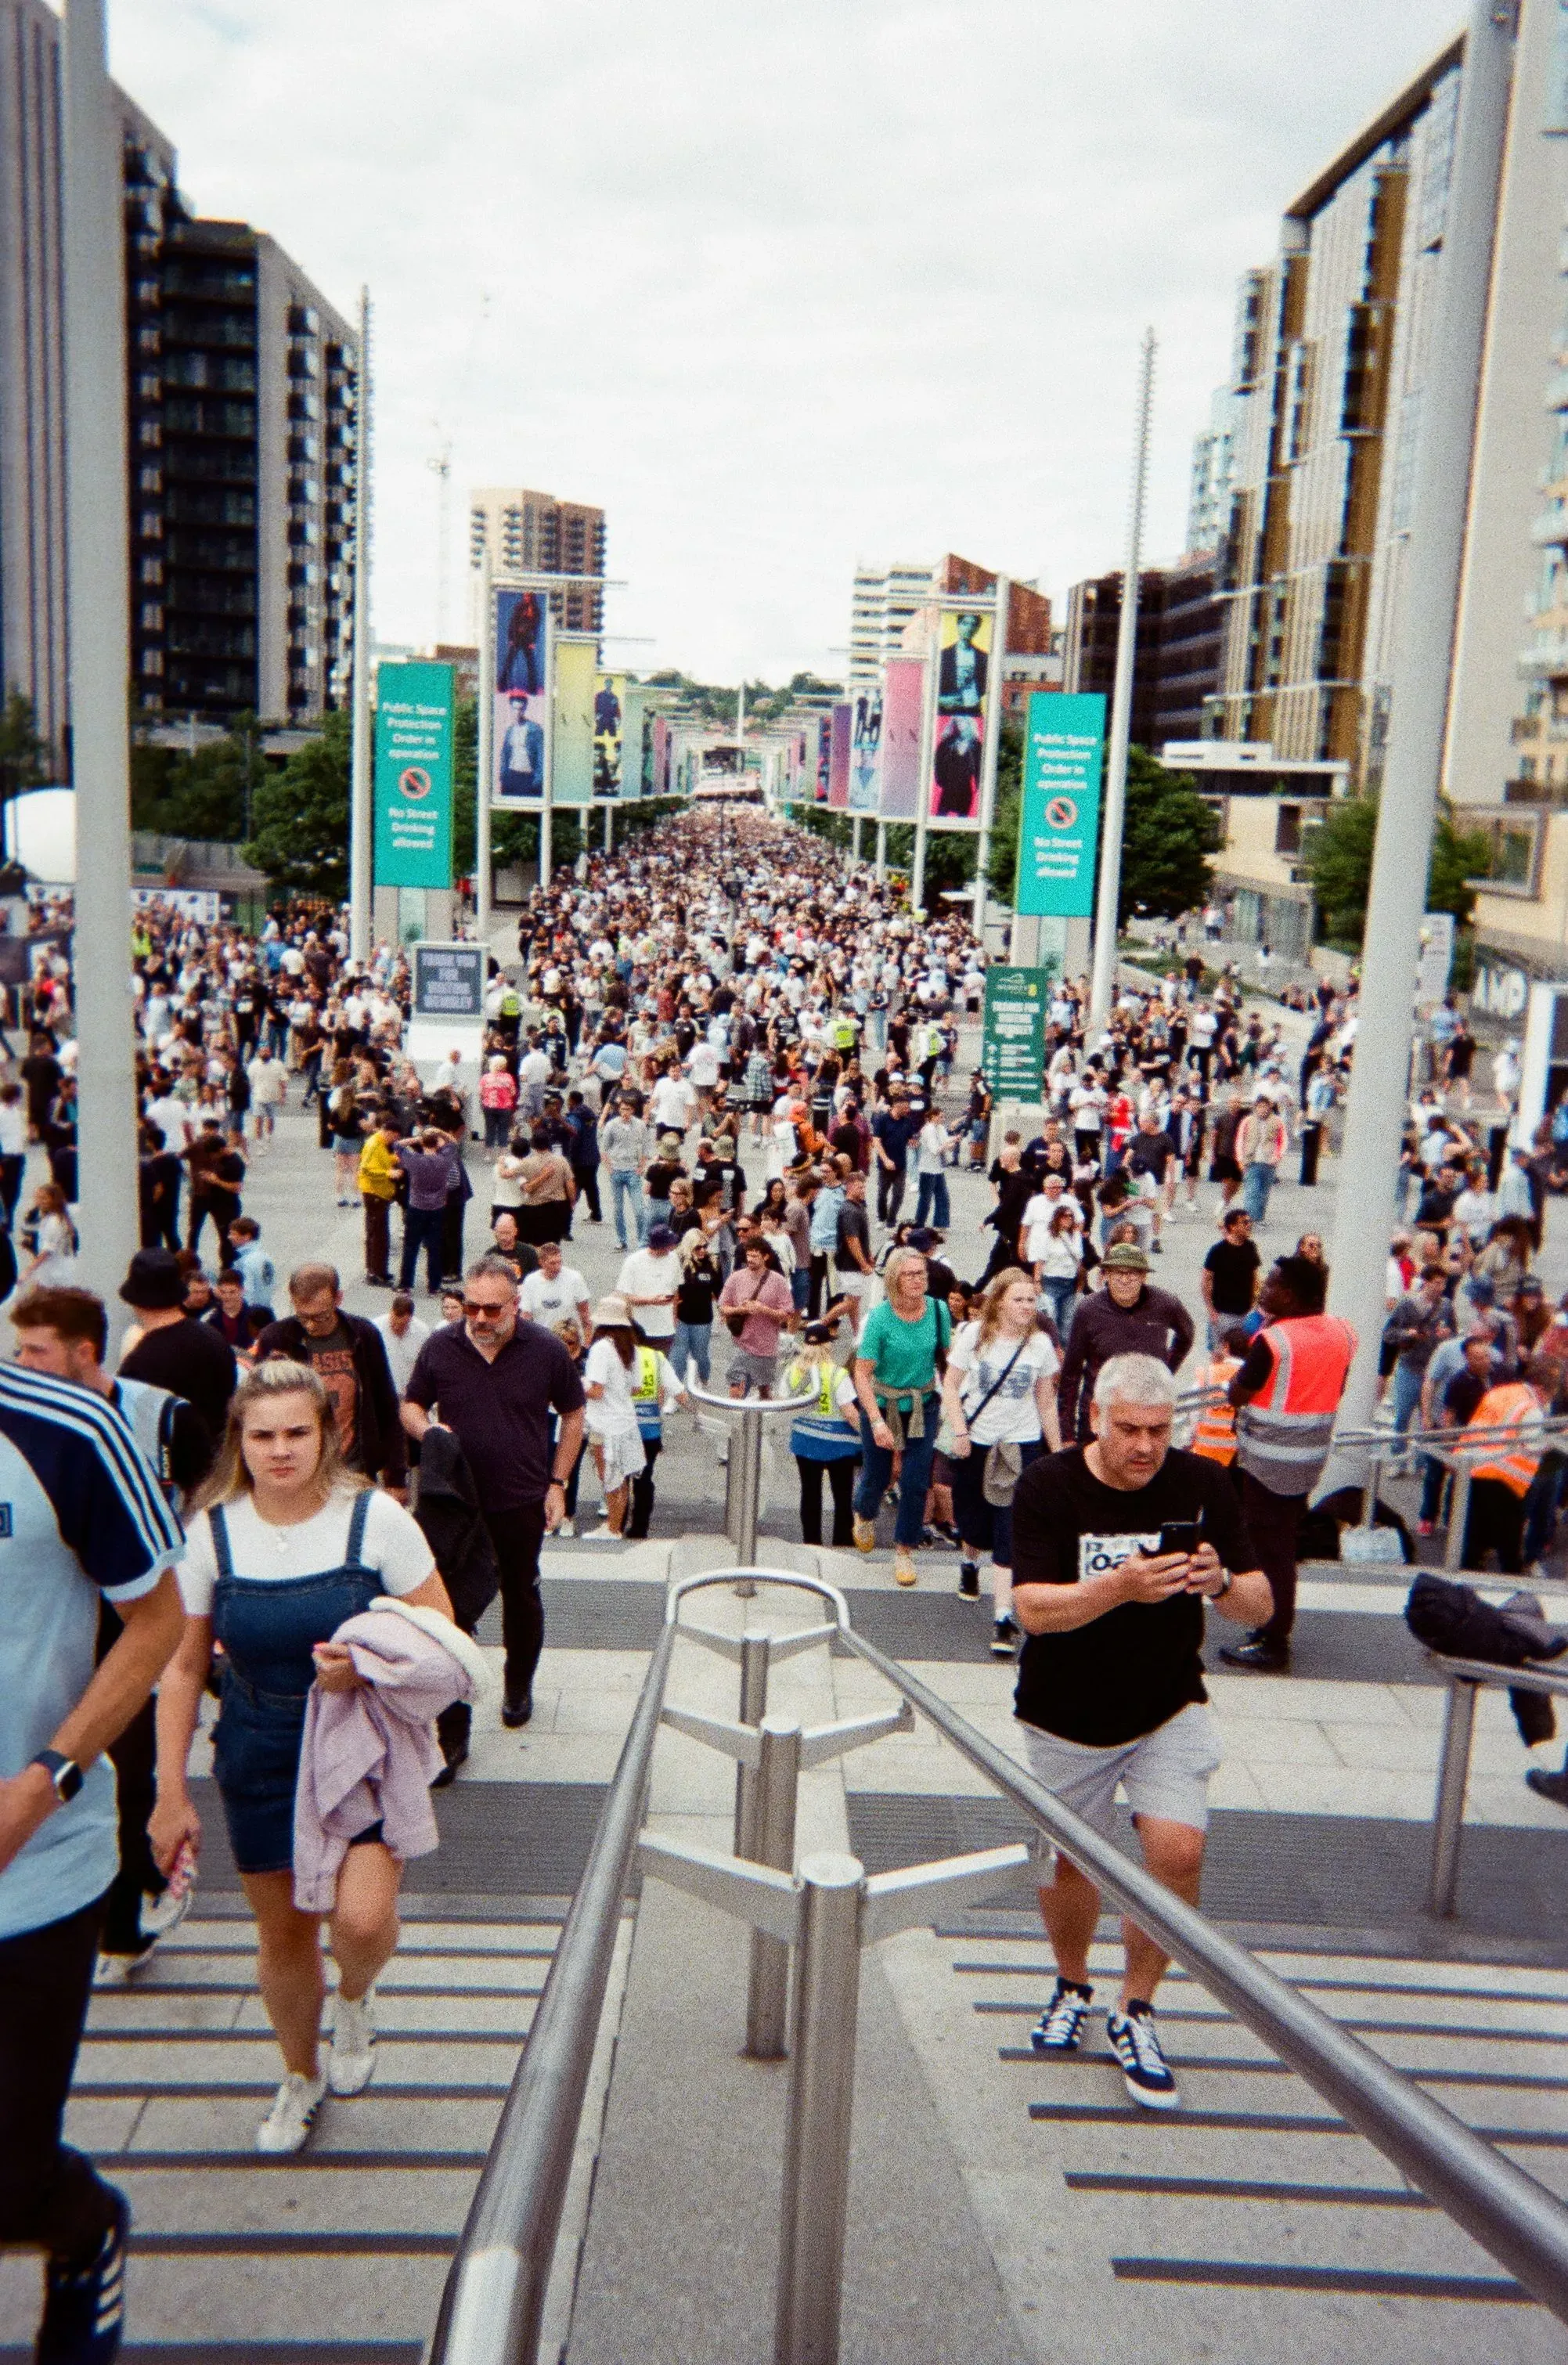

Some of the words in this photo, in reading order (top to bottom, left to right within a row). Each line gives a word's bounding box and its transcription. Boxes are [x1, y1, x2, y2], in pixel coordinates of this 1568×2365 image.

[382, 701, 414, 715] Public
[416, 704, 447, 716] Space
[387, 717, 442, 730] Protection
[392, 734, 423, 744] Order
[1033, 733, 1065, 745] Public
[1066, 734, 1097, 746] Space
[1036, 748, 1092, 759] Protection
[388, 807, 406, 819] No
[406, 809, 438, 820] Street
[391, 822, 435, 835] Drinking
